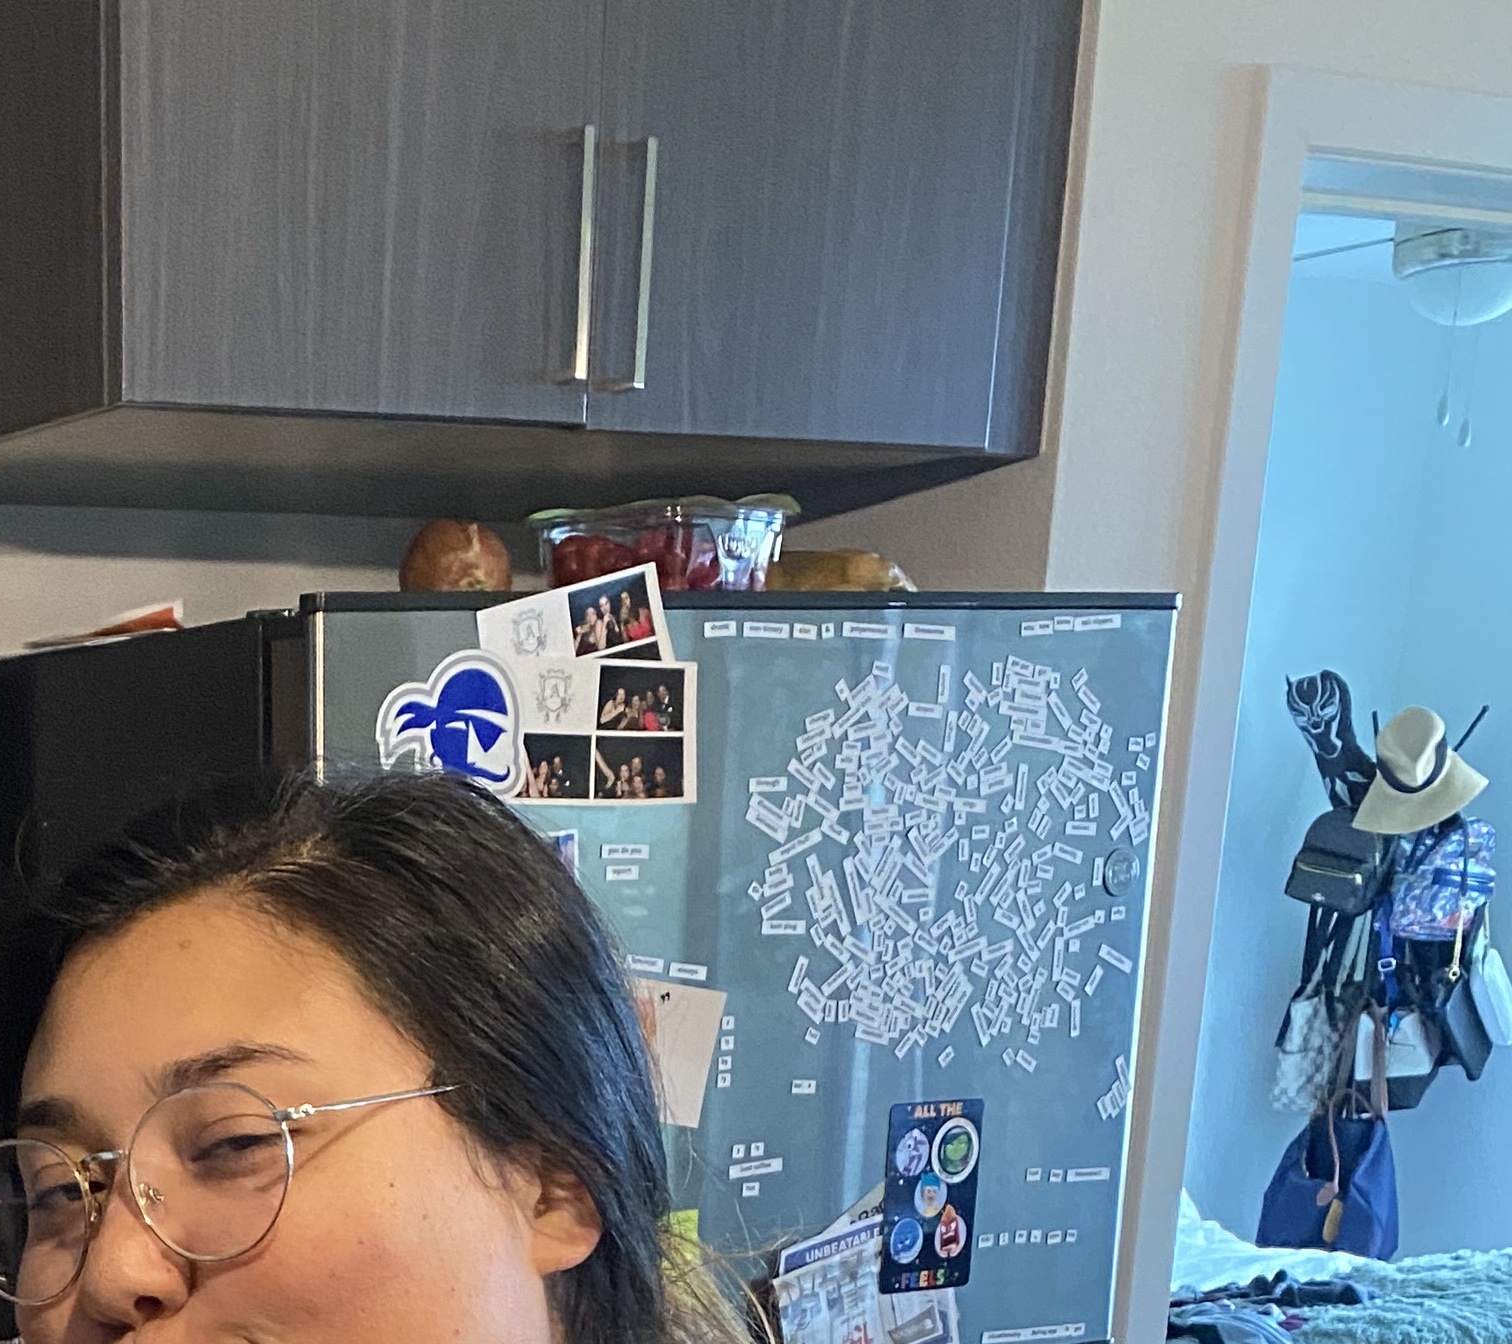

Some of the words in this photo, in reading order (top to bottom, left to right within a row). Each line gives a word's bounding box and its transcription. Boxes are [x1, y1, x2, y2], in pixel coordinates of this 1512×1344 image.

[914, 1104, 936, 1118] ALL
[939, 1102, 964, 1117] THE
[900, 1268, 945, 1289] FEELS
